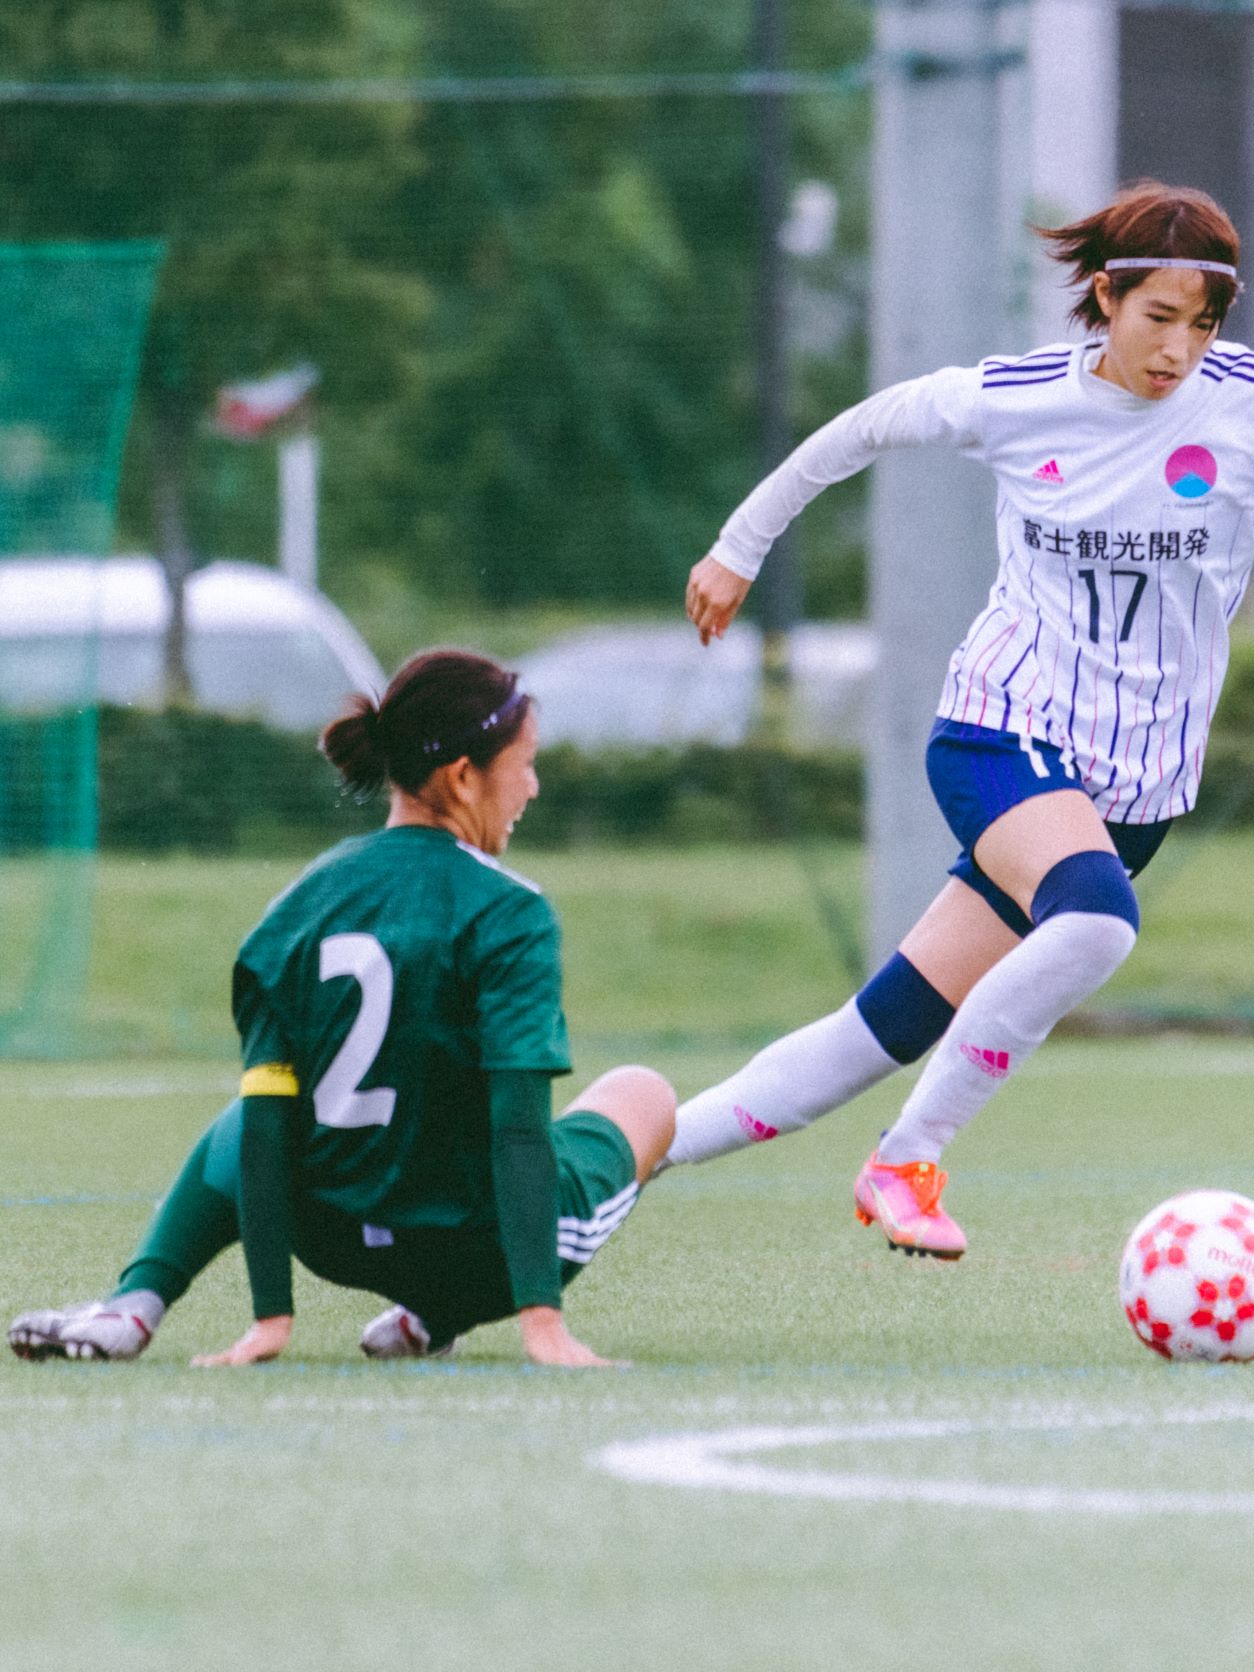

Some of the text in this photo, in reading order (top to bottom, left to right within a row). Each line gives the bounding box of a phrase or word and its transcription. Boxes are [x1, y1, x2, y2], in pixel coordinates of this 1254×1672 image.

[1024, 518, 1210, 562] 富士観光開発
[1077, 568, 1148, 644] 17
[313, 933, 397, 1128] 2
